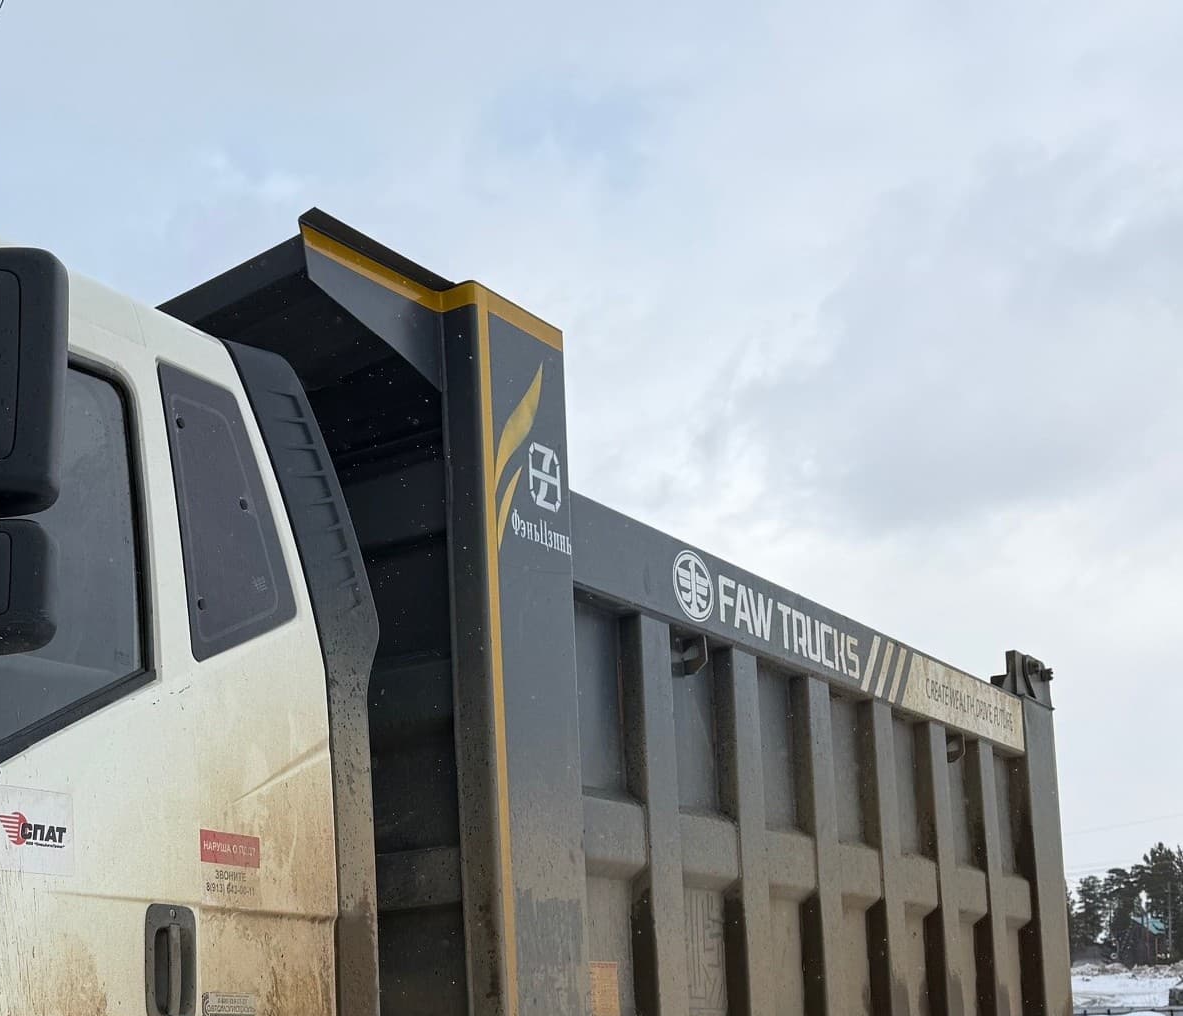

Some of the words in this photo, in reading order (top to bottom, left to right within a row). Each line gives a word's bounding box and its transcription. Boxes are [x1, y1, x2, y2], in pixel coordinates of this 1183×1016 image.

[718, 574, 774, 642] FAW
[777, 601, 861, 680] TRUCKS
[20, 822, 67, 843] СПАТ
[215, 870, 247, 882] ЗВОНИТЕ
